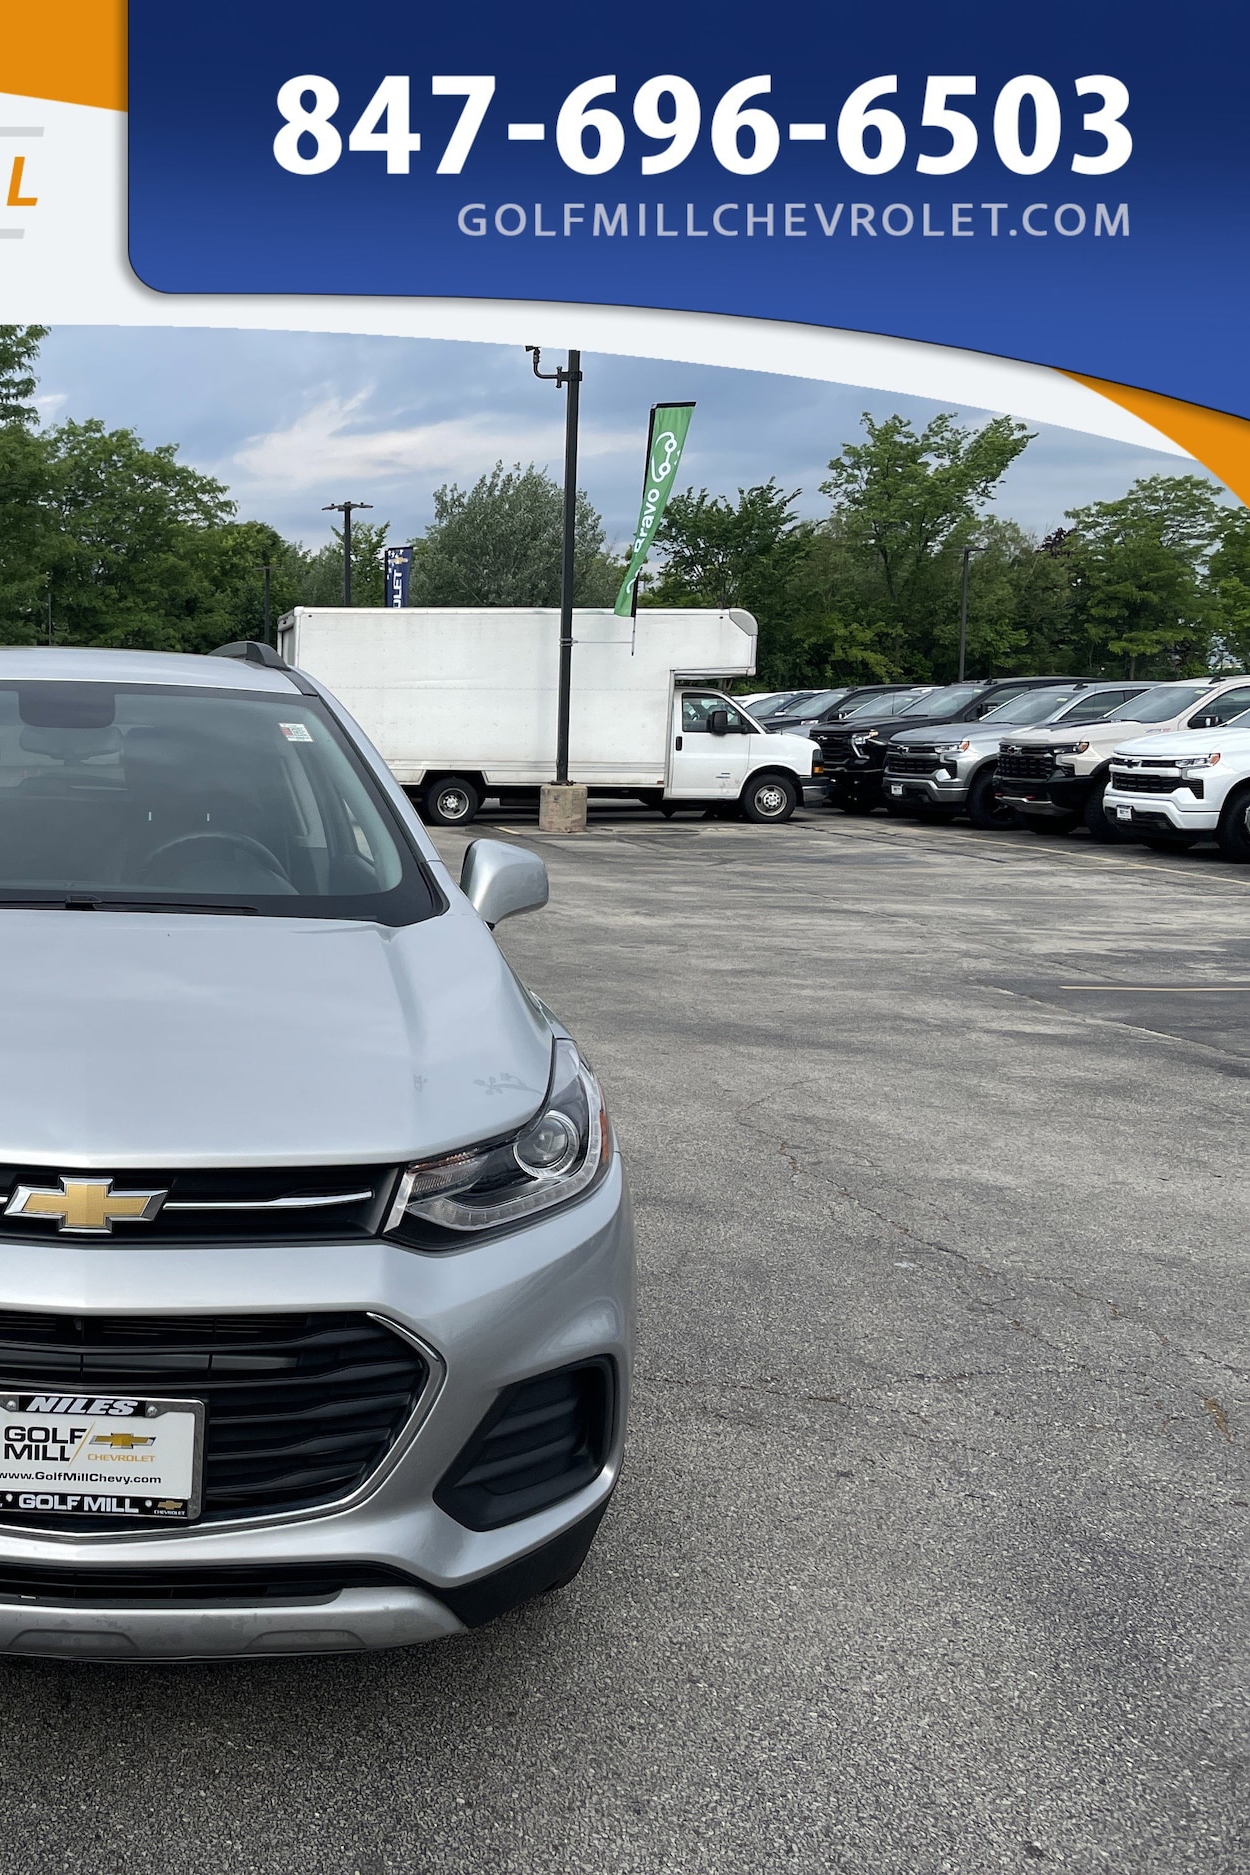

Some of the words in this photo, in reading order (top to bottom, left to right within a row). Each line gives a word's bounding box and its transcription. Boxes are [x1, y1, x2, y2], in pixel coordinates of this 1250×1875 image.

[26, 1396, 139, 1416] NILES
[3, 1425, 88, 1445] GOLF
[3, 1444, 72, 1462] MILL
[87, 1453, 156, 1462] CHEVROLET
[18, 1493, 81, 1511] GOLF
[83, 1496, 139, 1514] MILL
